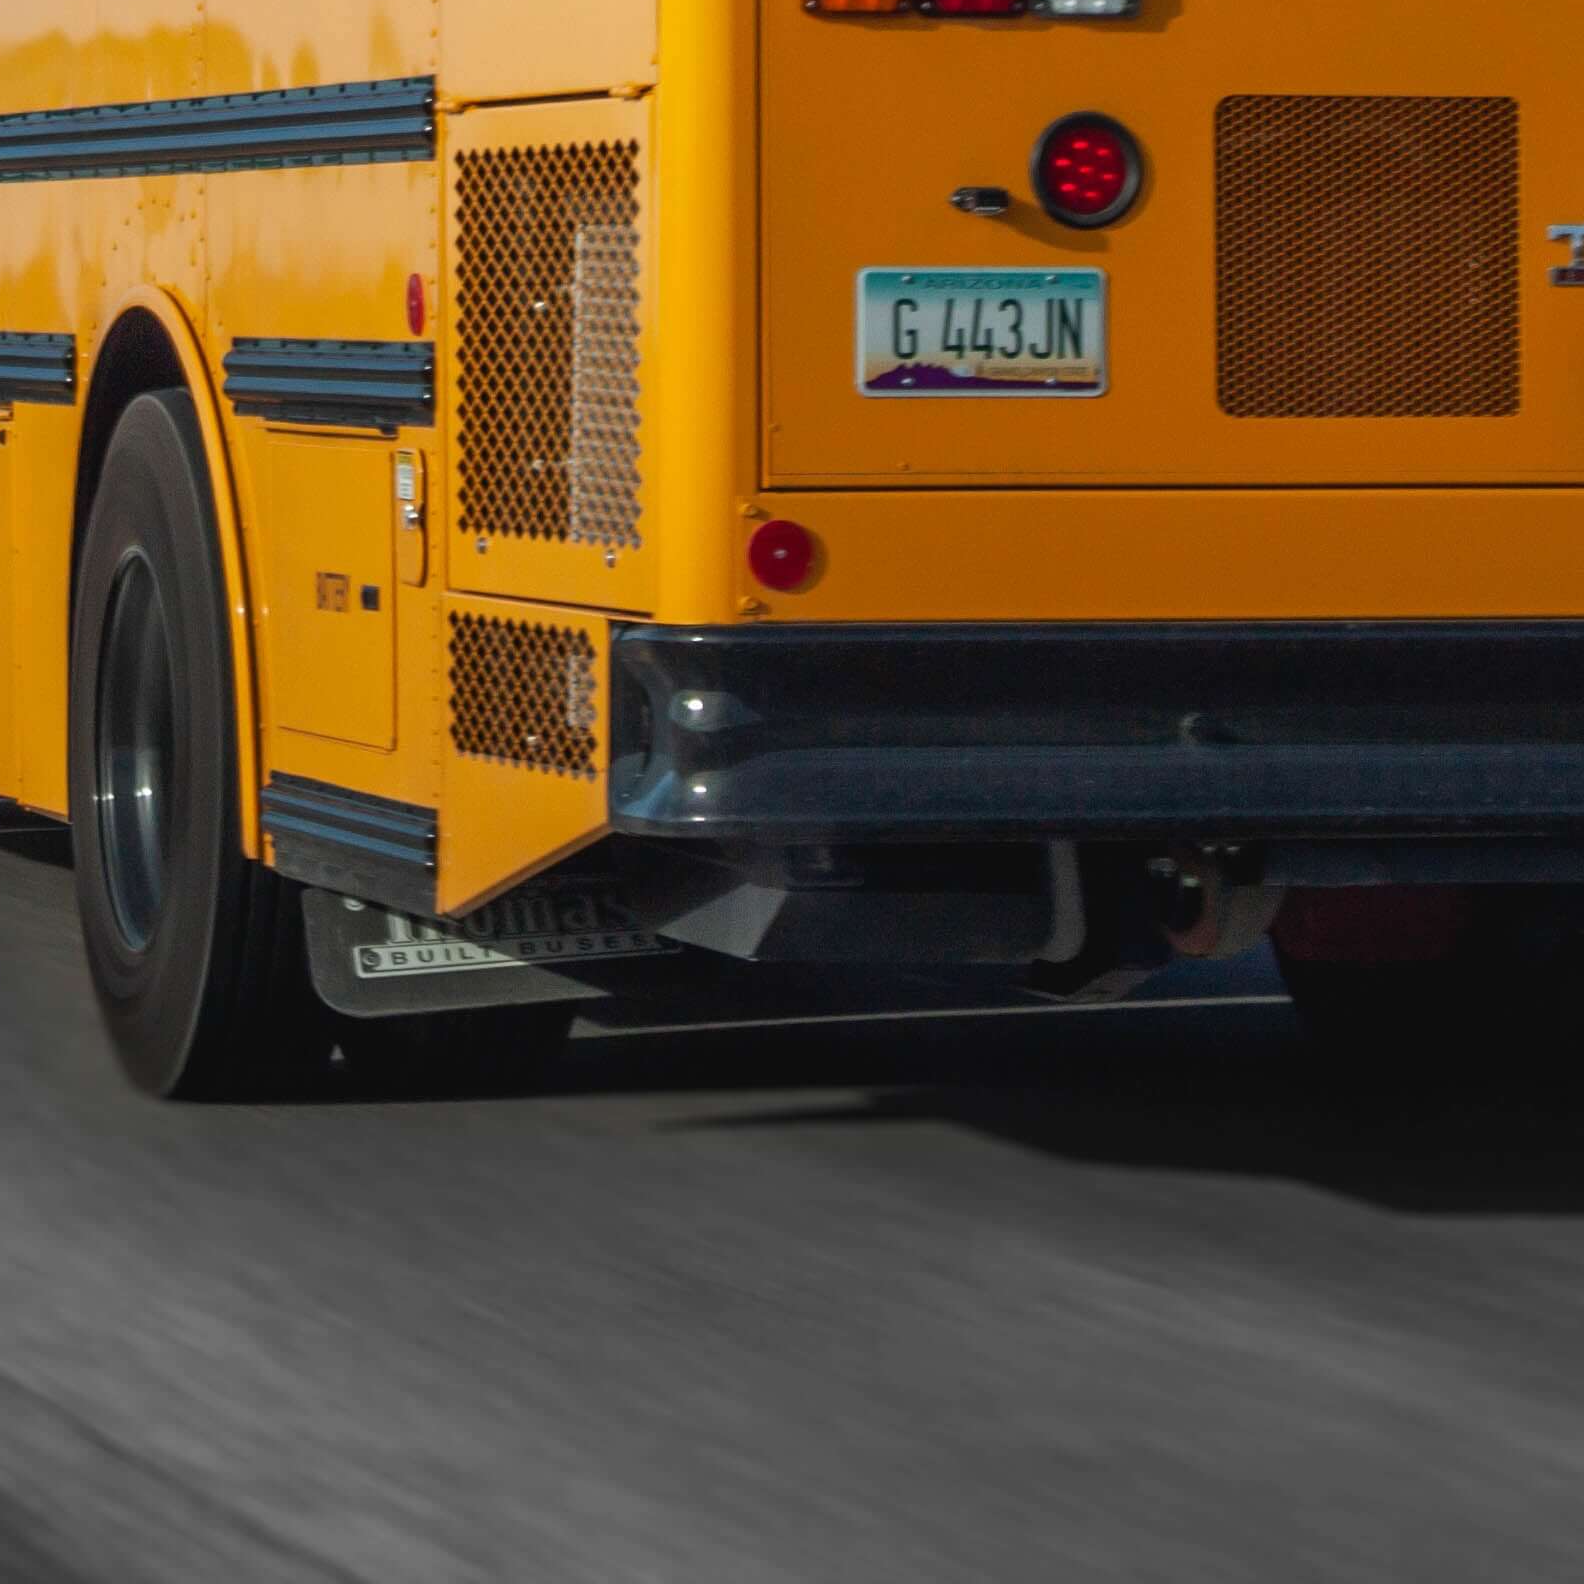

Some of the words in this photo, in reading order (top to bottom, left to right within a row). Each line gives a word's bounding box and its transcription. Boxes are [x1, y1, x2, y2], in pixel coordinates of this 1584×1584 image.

[893, 298, 919, 360] G
[941, 297, 1084, 360] 443JN
[389, 946, 495, 966] BUILT
[519, 934, 655, 956] BUSES
